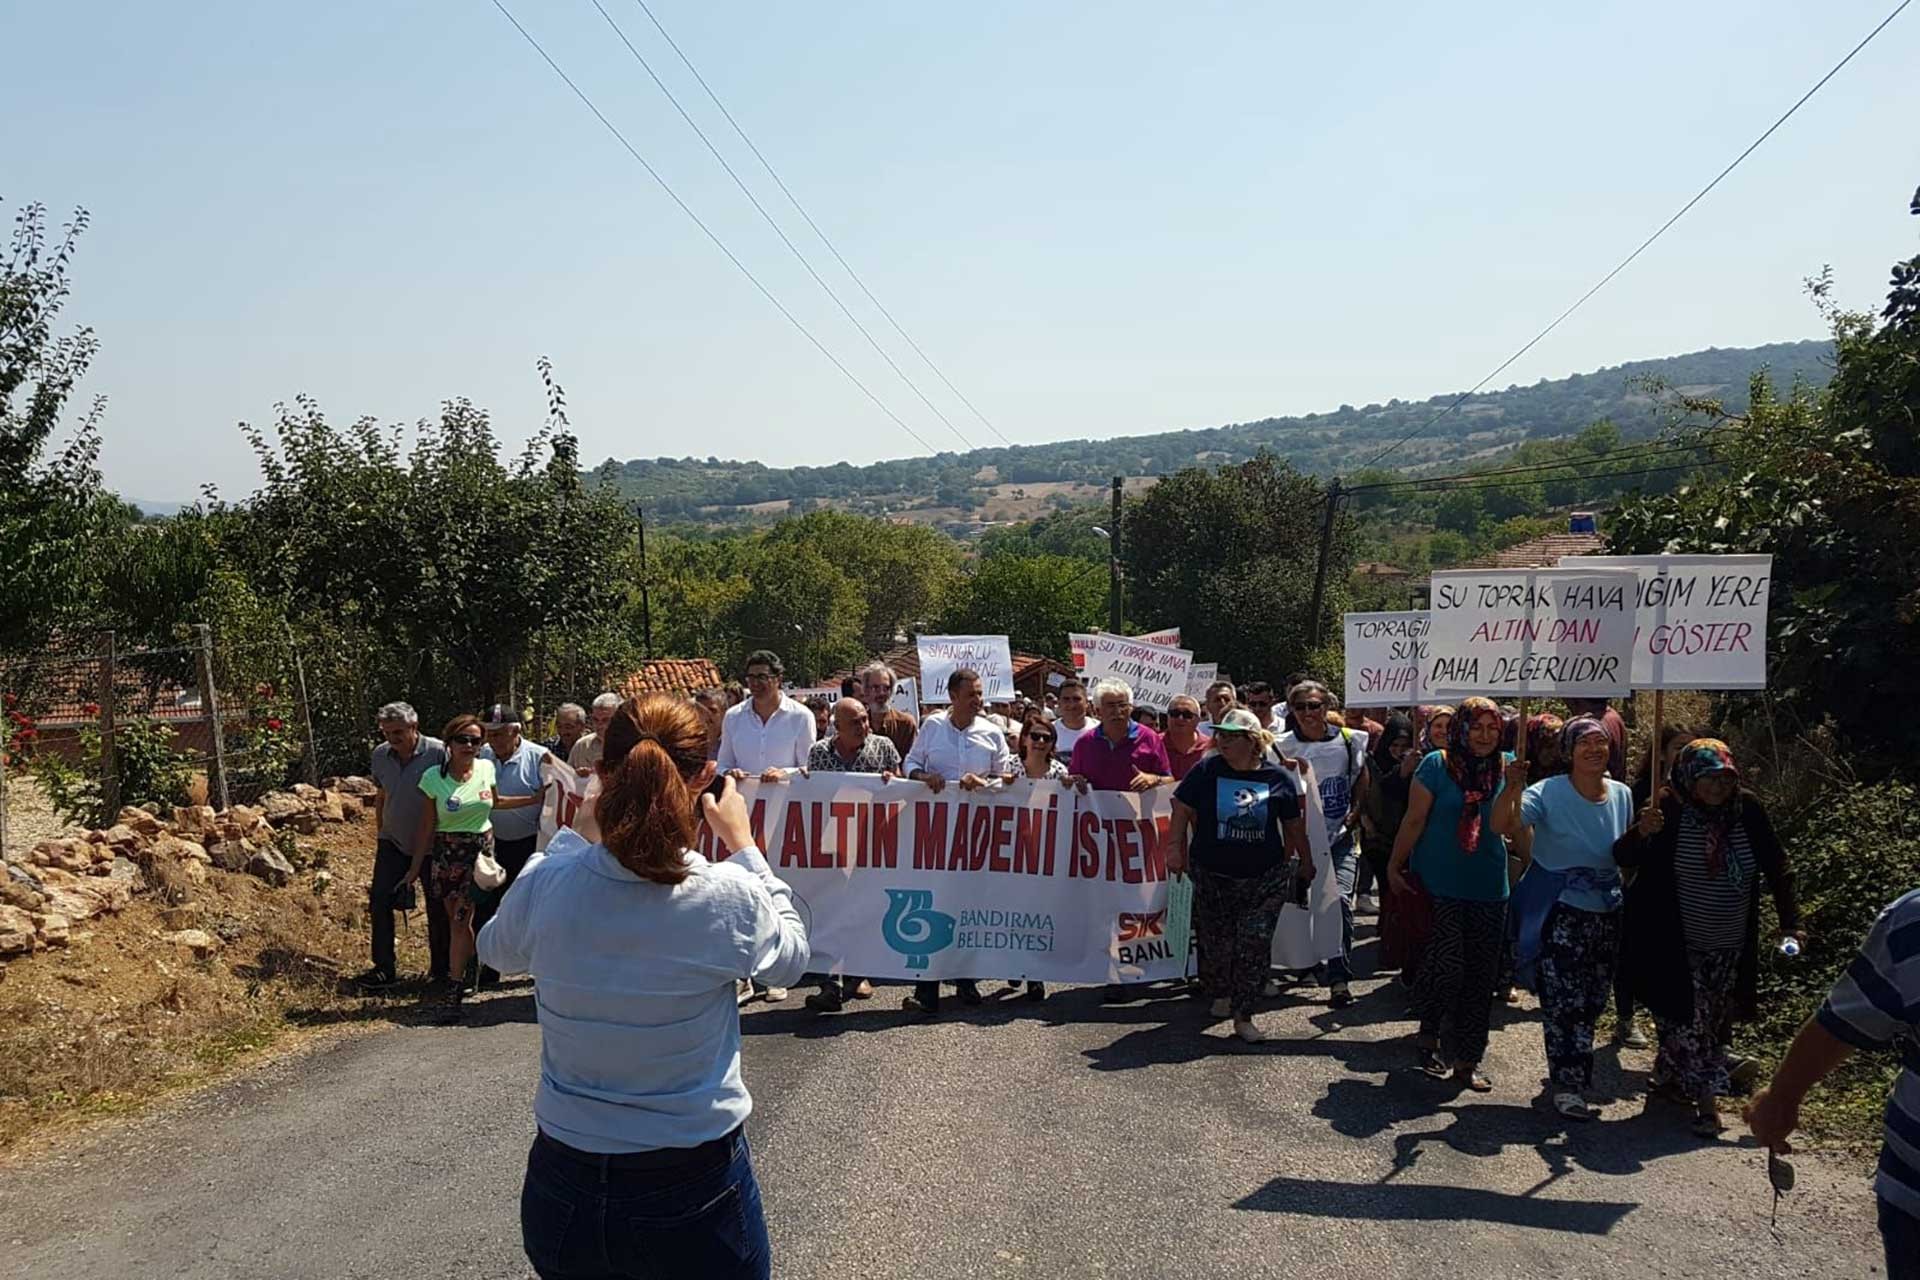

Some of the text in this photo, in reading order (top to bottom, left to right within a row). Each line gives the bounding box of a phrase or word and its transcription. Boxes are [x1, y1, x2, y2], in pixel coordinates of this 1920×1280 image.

[1437, 584, 1623, 611] SU TOPRAK HAVA
[1705, 576, 1769, 608] YERE
[1649, 619, 1752, 655] GÖSTER
[1098, 639, 1115, 654] SU
[1118, 643, 1158, 664] TOPRAK
[1431, 657, 1479, 683] DAHA
[779, 800, 899, 870] ALTIN
[913, 793, 1058, 878] MADENİ
[960, 909, 1055, 931] BANDIRMA
[958, 929, 1055, 952] BELEDİYESİ
